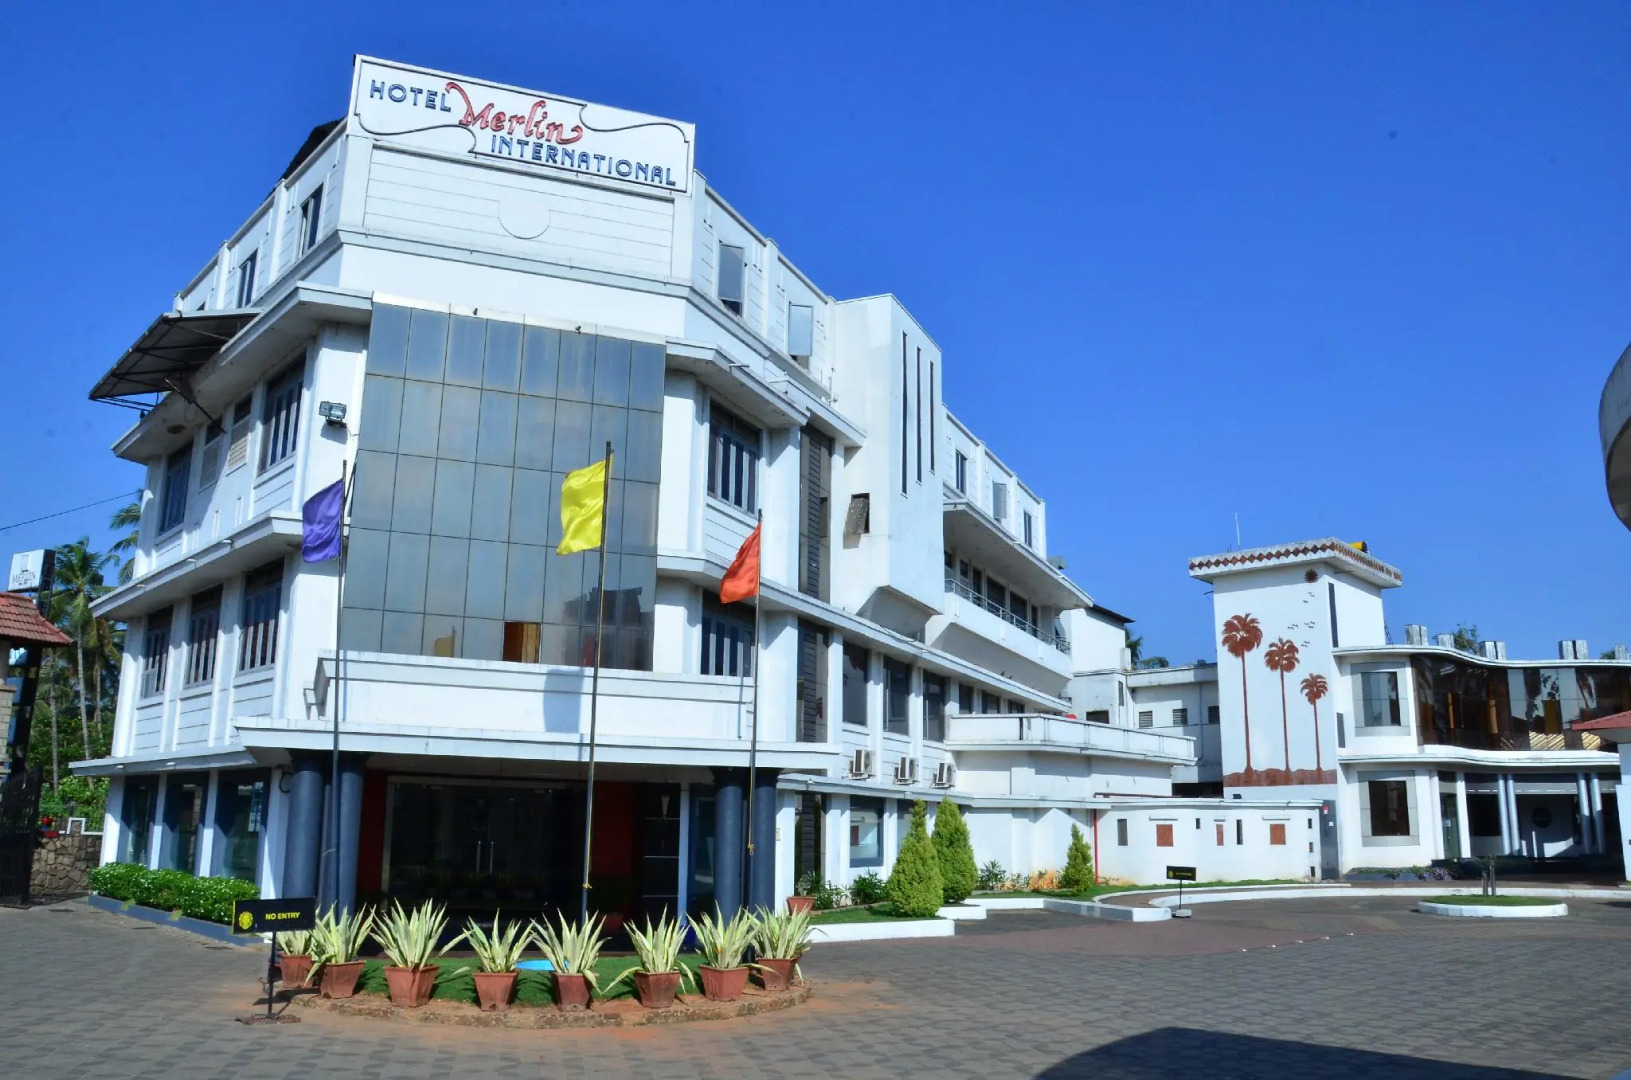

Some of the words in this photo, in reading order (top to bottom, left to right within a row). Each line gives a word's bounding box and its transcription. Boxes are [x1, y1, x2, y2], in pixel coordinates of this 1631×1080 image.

[370, 79, 452, 112] HOTEL
[445, 81, 583, 145] Merlin
[491, 134, 676, 187] INTERNATIONAL
[277, 911, 301, 920] ENTRY
